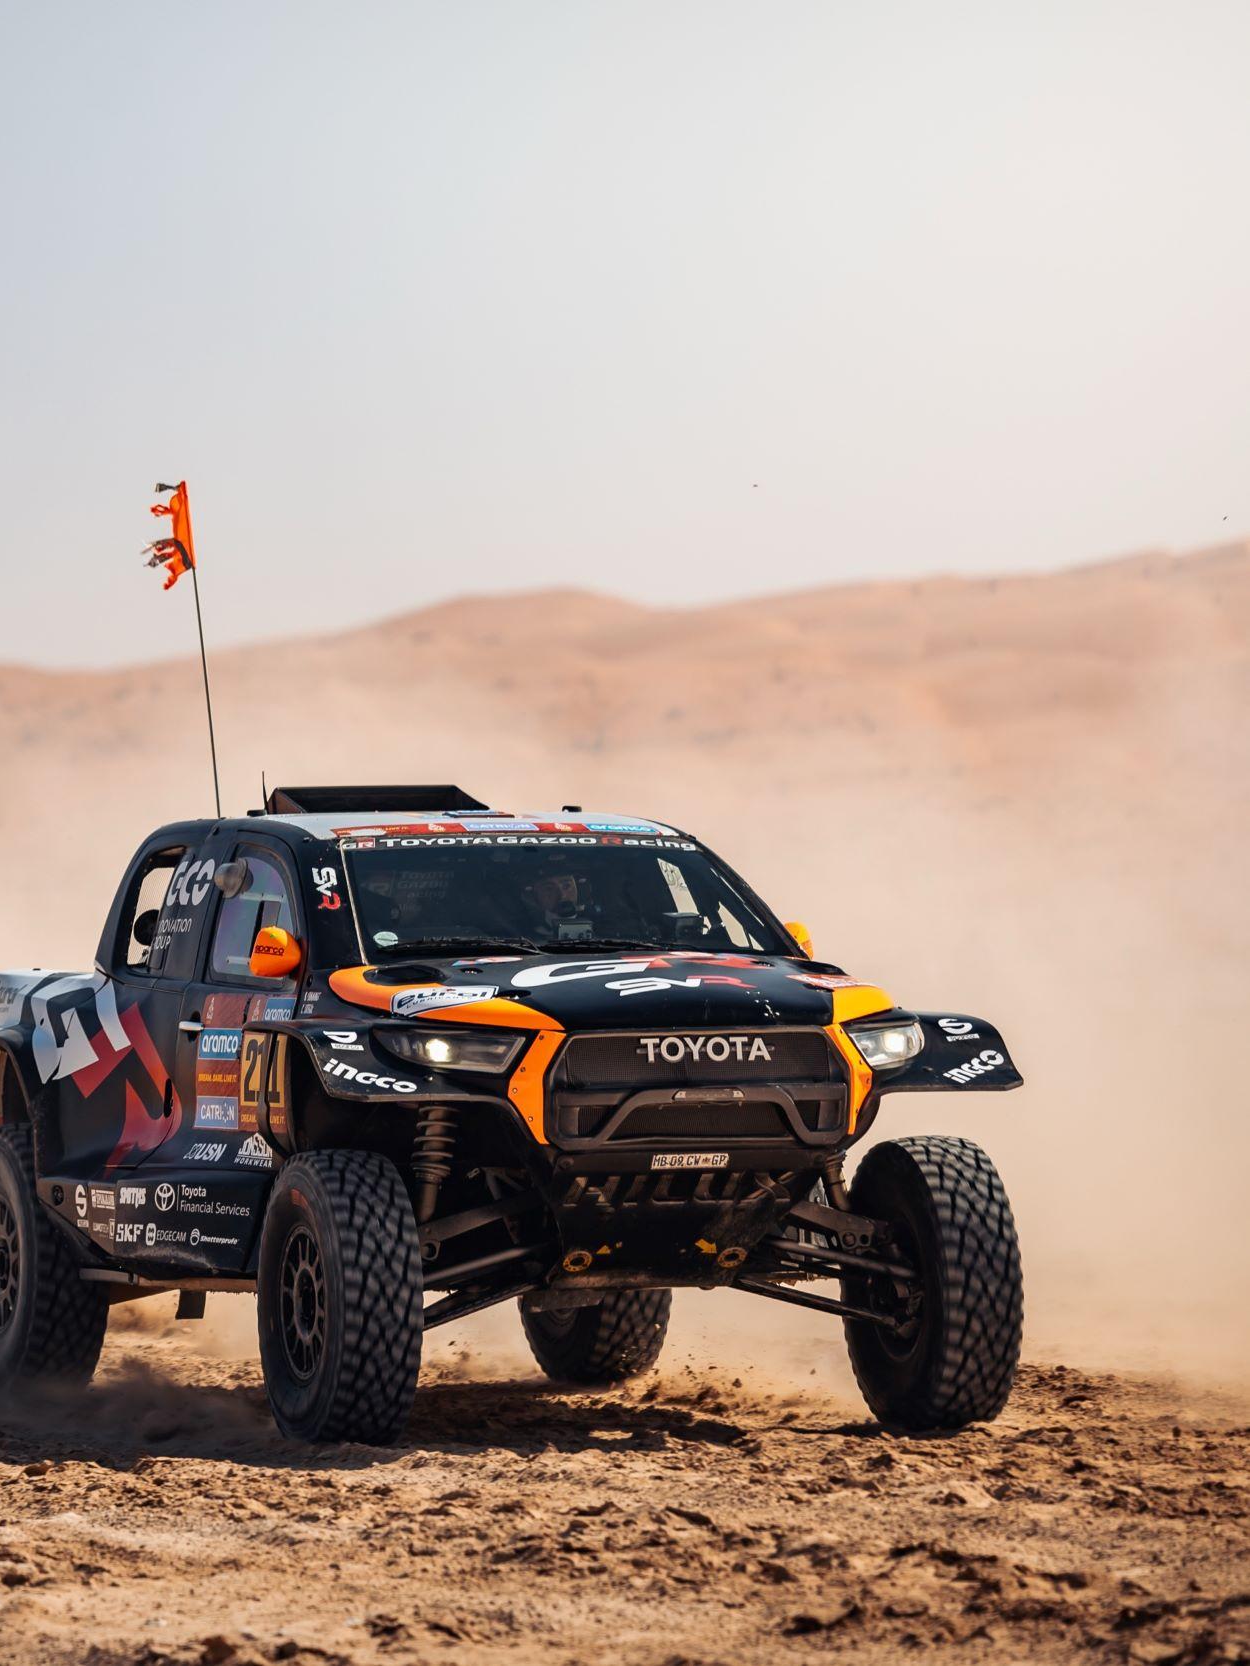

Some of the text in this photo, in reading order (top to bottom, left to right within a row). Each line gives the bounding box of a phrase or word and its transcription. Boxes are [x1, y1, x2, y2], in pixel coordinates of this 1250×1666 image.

[379, 836, 696, 852] TOYOTA GAZOO Racing
[202, 1034, 238, 1054] aramco
[640, 1036, 772, 1063] TOYOTA
[234, 1157, 273, 1168] WORKWEAR
[181, 1184, 207, 1199] Toyota
[180, 1200, 251, 1217] Financial Services
[115, 1223, 144, 1242] SKF
[156, 1229, 187, 1242] EDGECAM
